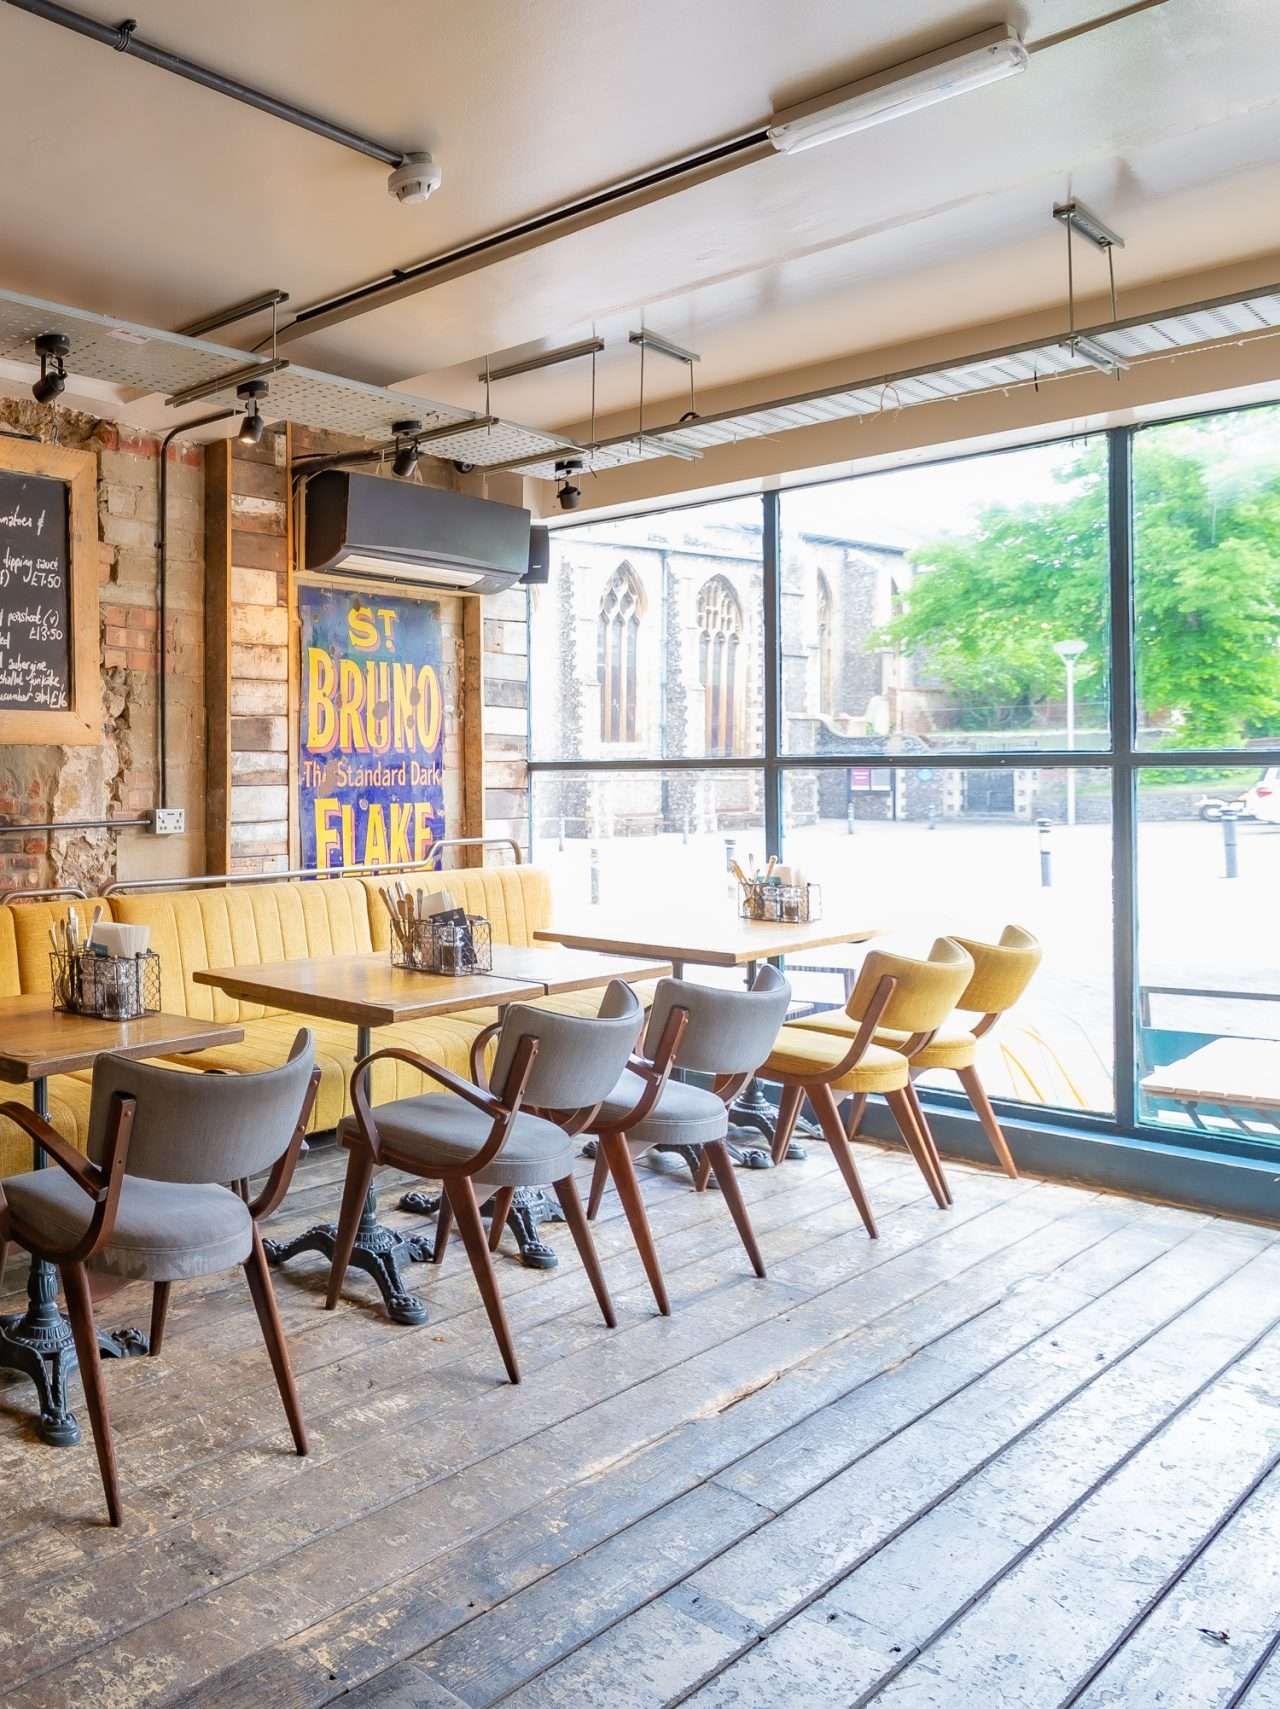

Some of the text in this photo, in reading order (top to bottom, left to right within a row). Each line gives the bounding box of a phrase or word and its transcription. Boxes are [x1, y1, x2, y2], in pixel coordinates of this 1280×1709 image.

[37, 509, 46, 536] &
[2, 546, 33, 583] dipping
[35, 557, 58, 571] sauce
[31, 571, 61, 588] £7.50
[42, 609, 59, 627] (v)
[29, 626, 63, 641] £13.50
[50, 691, 68, 708] £16
[306, 647, 443, 754] BRUNO
[336, 760, 406, 787] Standard
[411, 760, 441, 786] Dark
[314, 798, 435, 880] FLAKE
